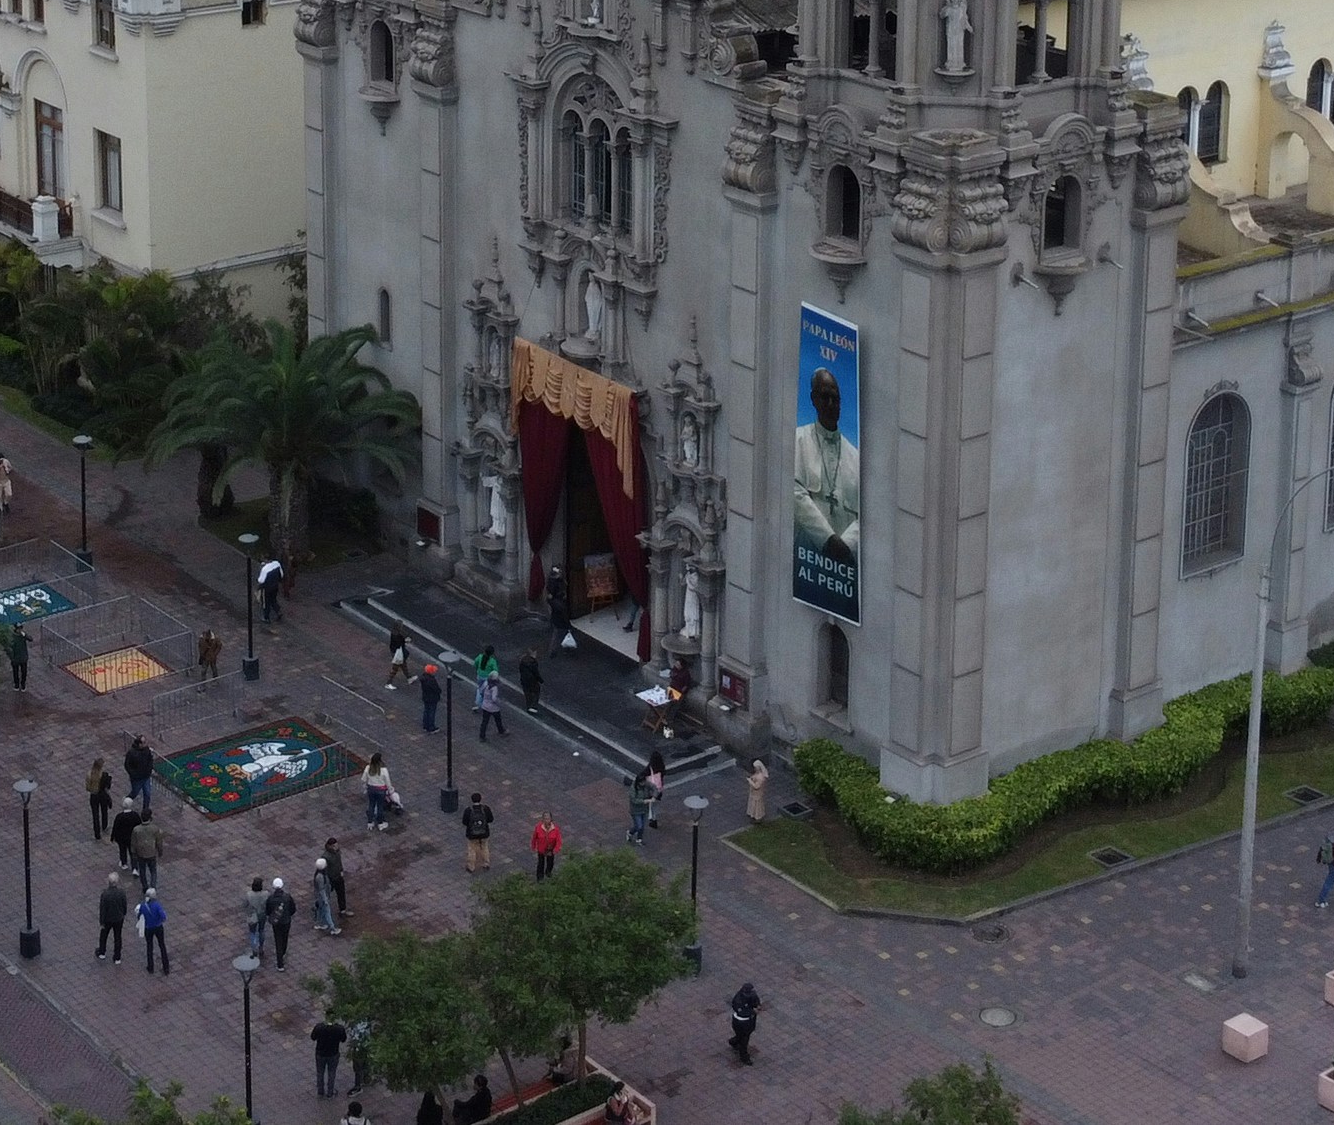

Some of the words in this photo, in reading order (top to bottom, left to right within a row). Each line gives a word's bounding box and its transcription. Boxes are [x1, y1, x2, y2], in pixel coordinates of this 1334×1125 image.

[802, 318, 827, 340] PAPA
[829, 331, 855, 352] LEÓN
[819, 345, 838, 362] XIV
[797, 545, 855, 581] BENDICE
[798, 565, 814, 583] AL
[818, 573, 854, 598] PERÚ
